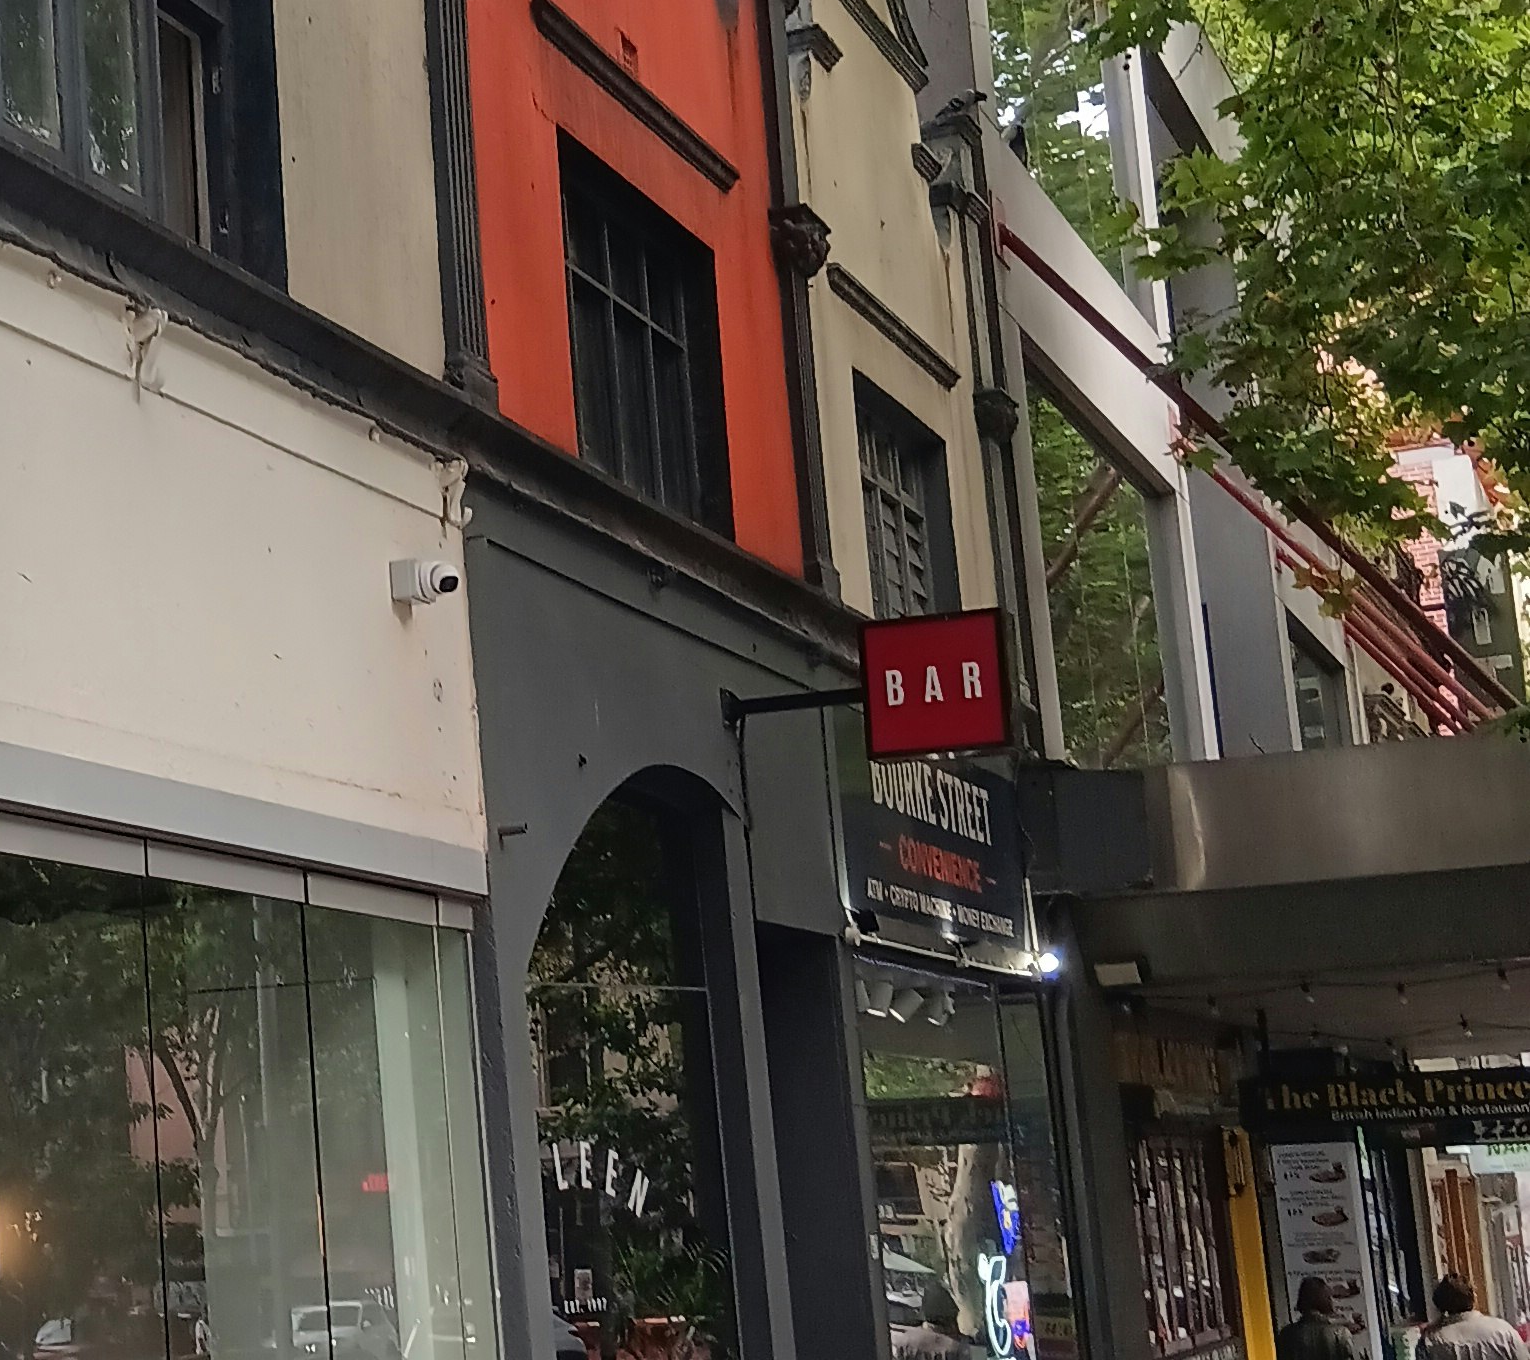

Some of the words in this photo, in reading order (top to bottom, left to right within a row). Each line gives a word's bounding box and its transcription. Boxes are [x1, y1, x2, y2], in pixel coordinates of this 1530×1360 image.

[885, 661, 983, 706] BAR
[870, 759, 937, 826] BOURKE
[936, 768, 992, 846] STREET
[898, 833, 983, 894] CONVENIENCE
[1327, 1078, 1417, 1107] Black
[1375, 1106, 1418, 1120] Indian
